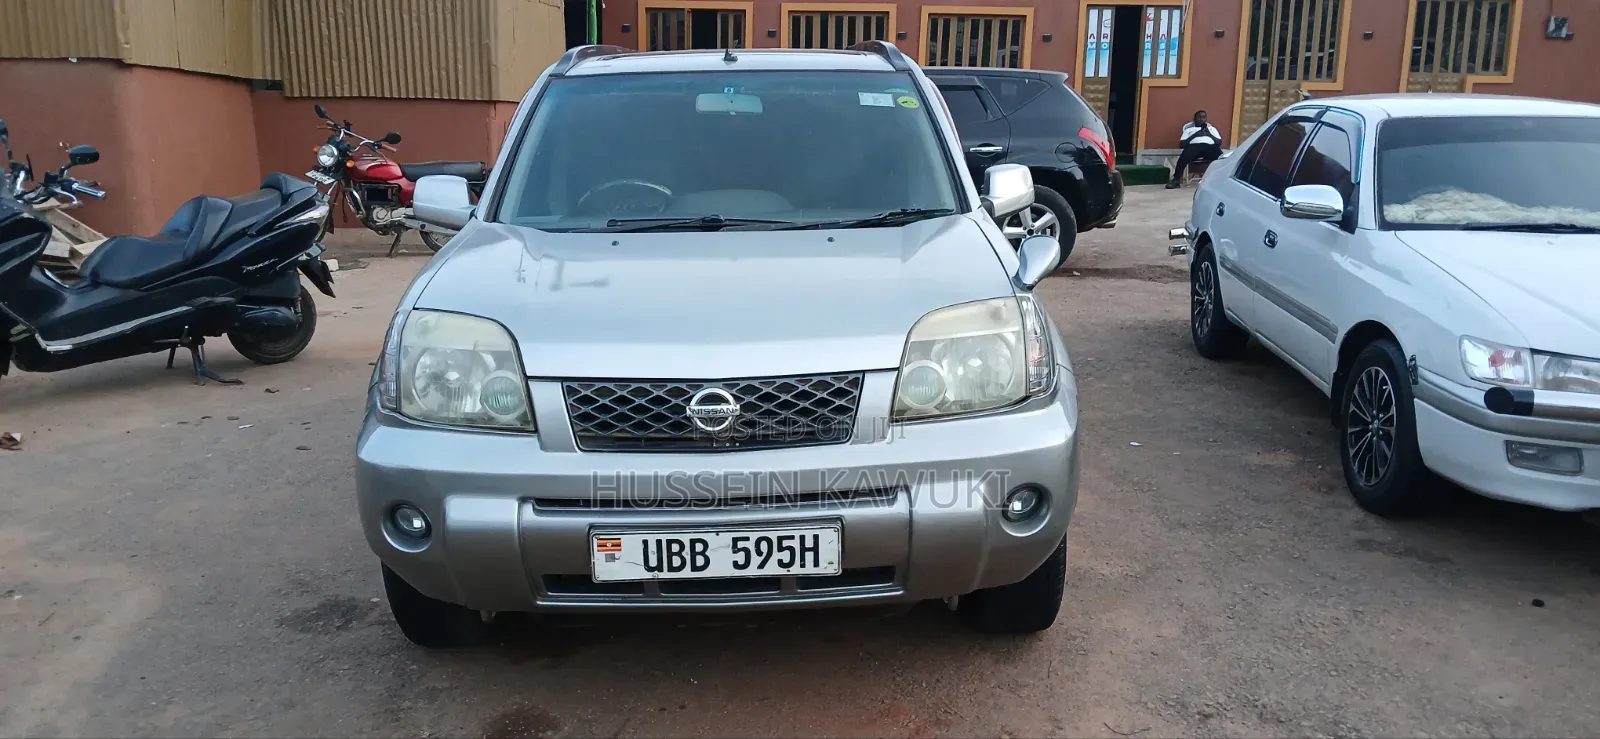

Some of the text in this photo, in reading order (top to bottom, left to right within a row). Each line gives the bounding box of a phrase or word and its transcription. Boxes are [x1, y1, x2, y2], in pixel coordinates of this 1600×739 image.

[690, 407, 735, 416] NISSAN
[641, 533, 820, 573] UBB 595H
